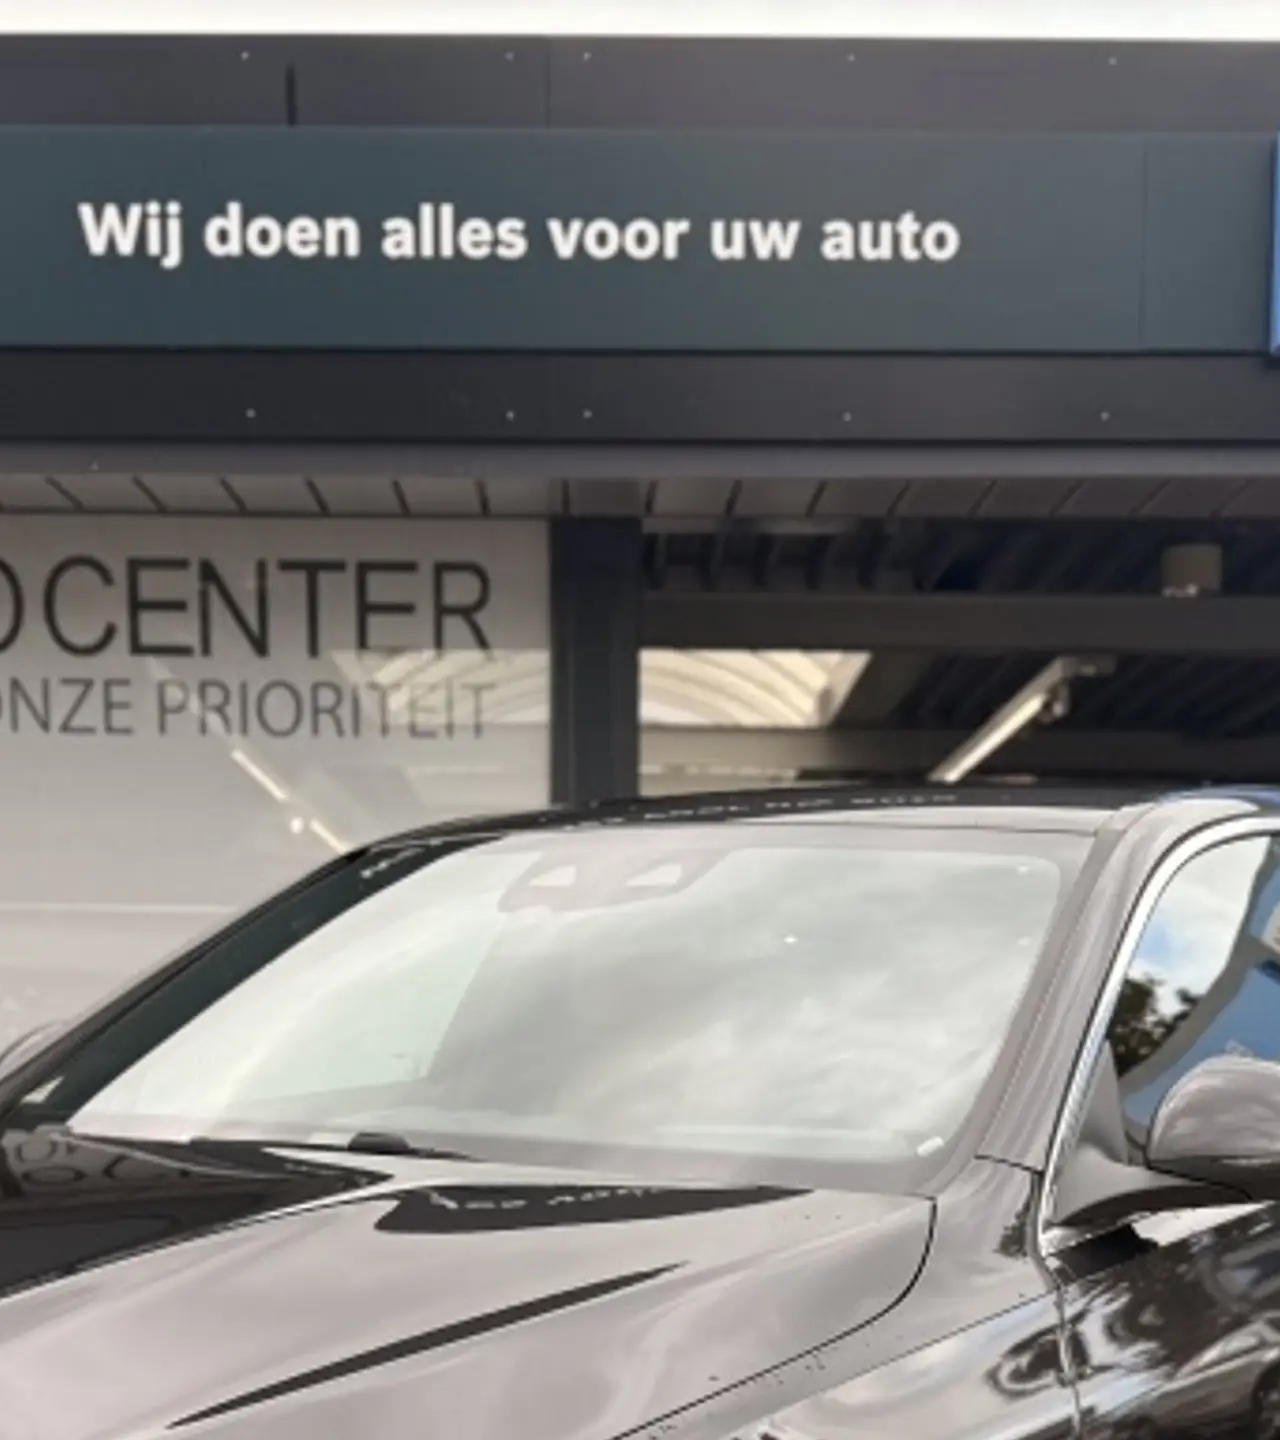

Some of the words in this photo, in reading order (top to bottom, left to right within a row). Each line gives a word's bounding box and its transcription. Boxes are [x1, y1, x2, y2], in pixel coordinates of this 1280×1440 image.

[78, 202, 182, 269] Wij
[204, 202, 361, 258] doen
[381, 202, 528, 259] alles
[547, 217, 690, 260] voor
[710, 219, 801, 261] uw
[820, 211, 960, 261] auto
[158, 680, 496, 738] PRIORITEIT
